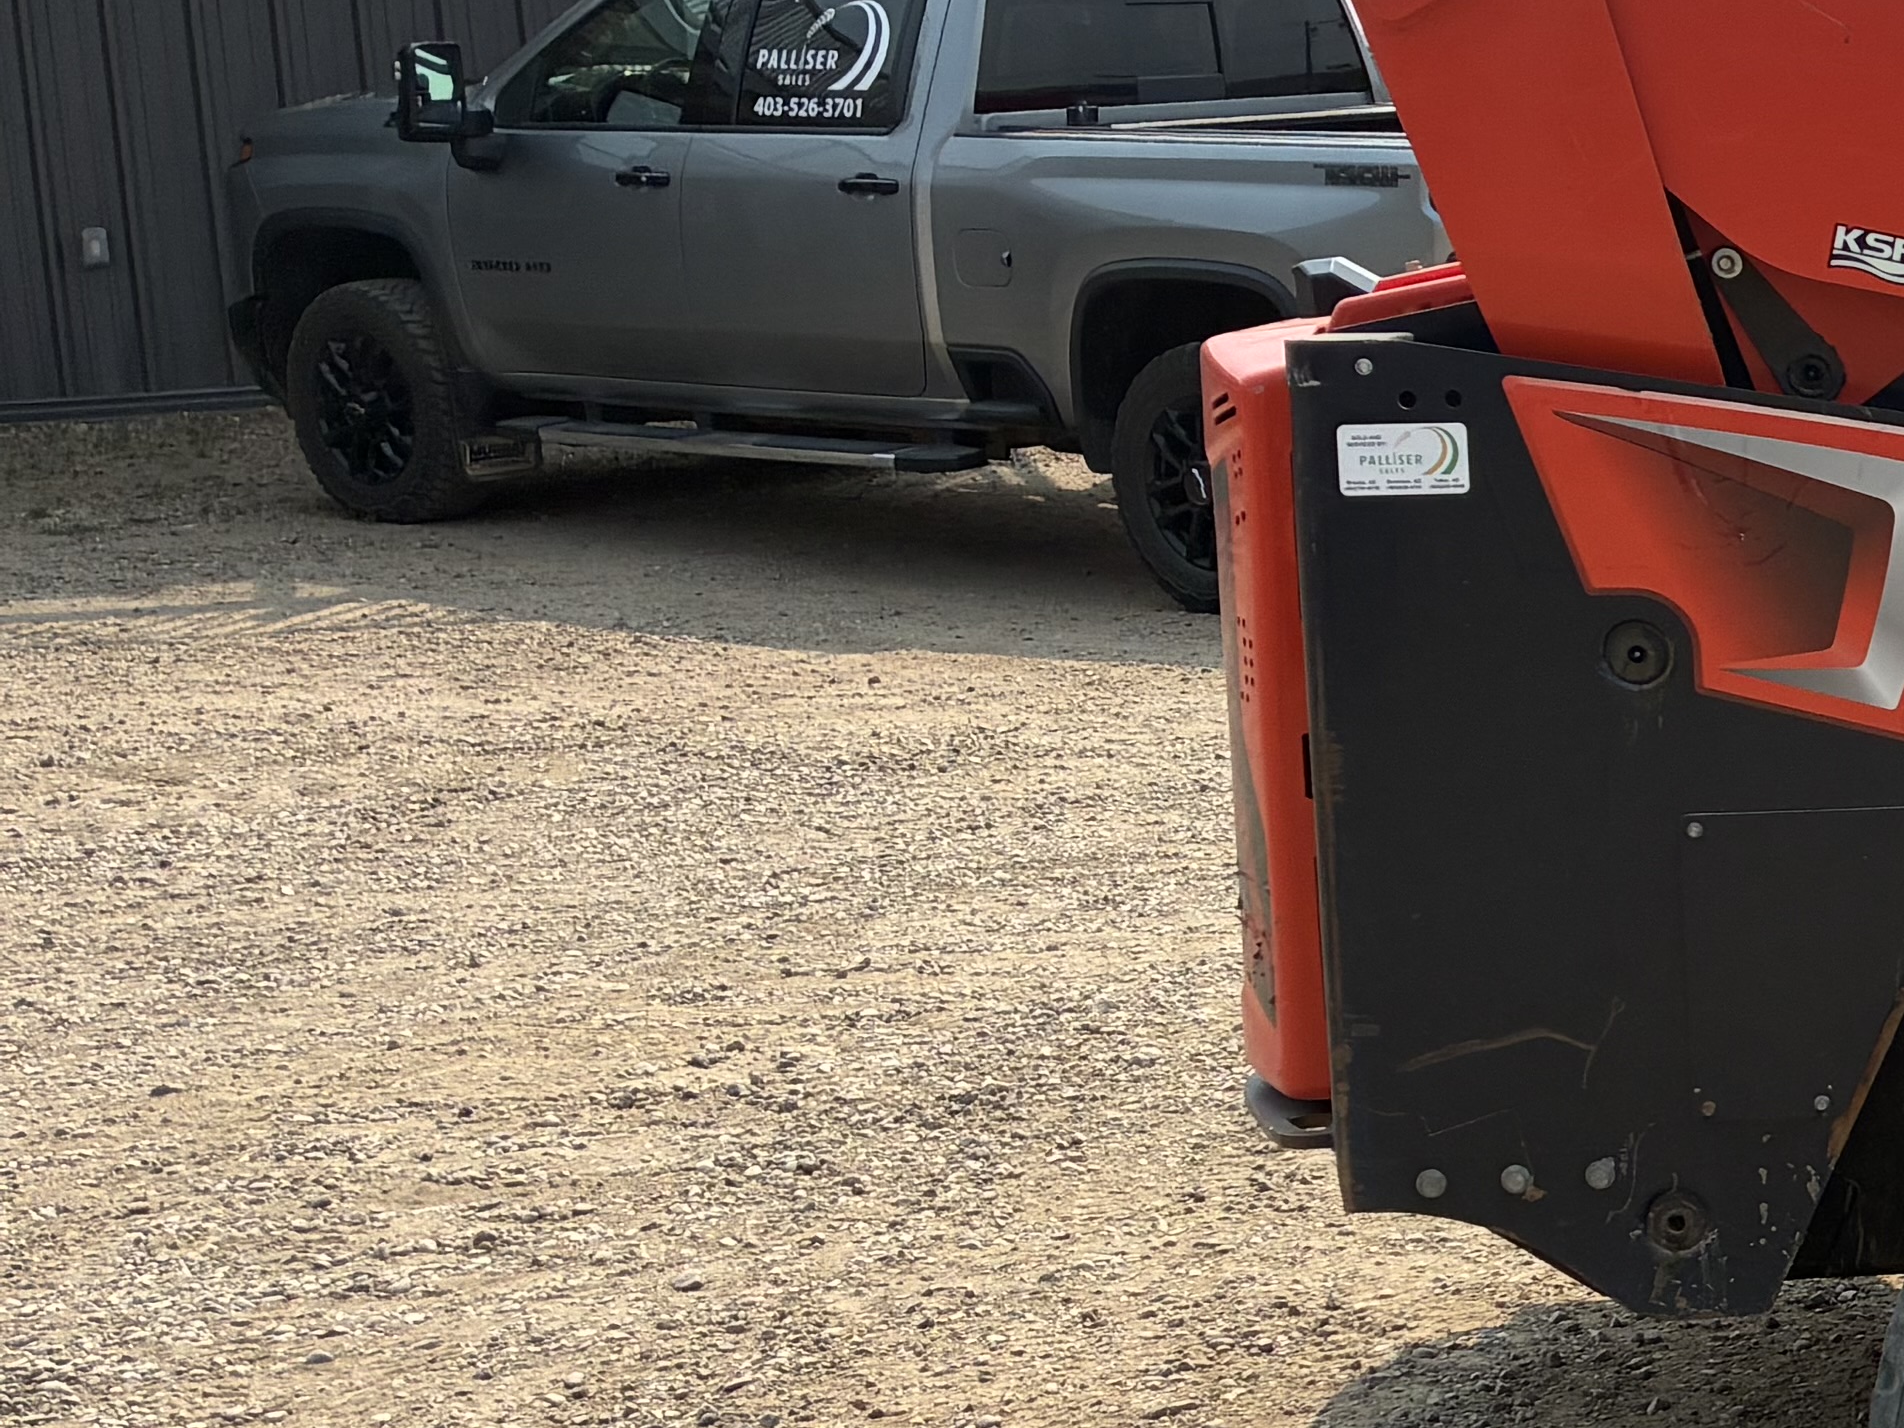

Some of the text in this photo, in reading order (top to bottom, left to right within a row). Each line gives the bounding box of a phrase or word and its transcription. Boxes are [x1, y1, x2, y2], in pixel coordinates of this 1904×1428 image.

[756, 45, 839, 70] PALLISER
[777, 74, 811, 86] SALES
[753, 96, 863, 118] 403-526-3701
[1359, 452, 1423, 466] PALLISER
